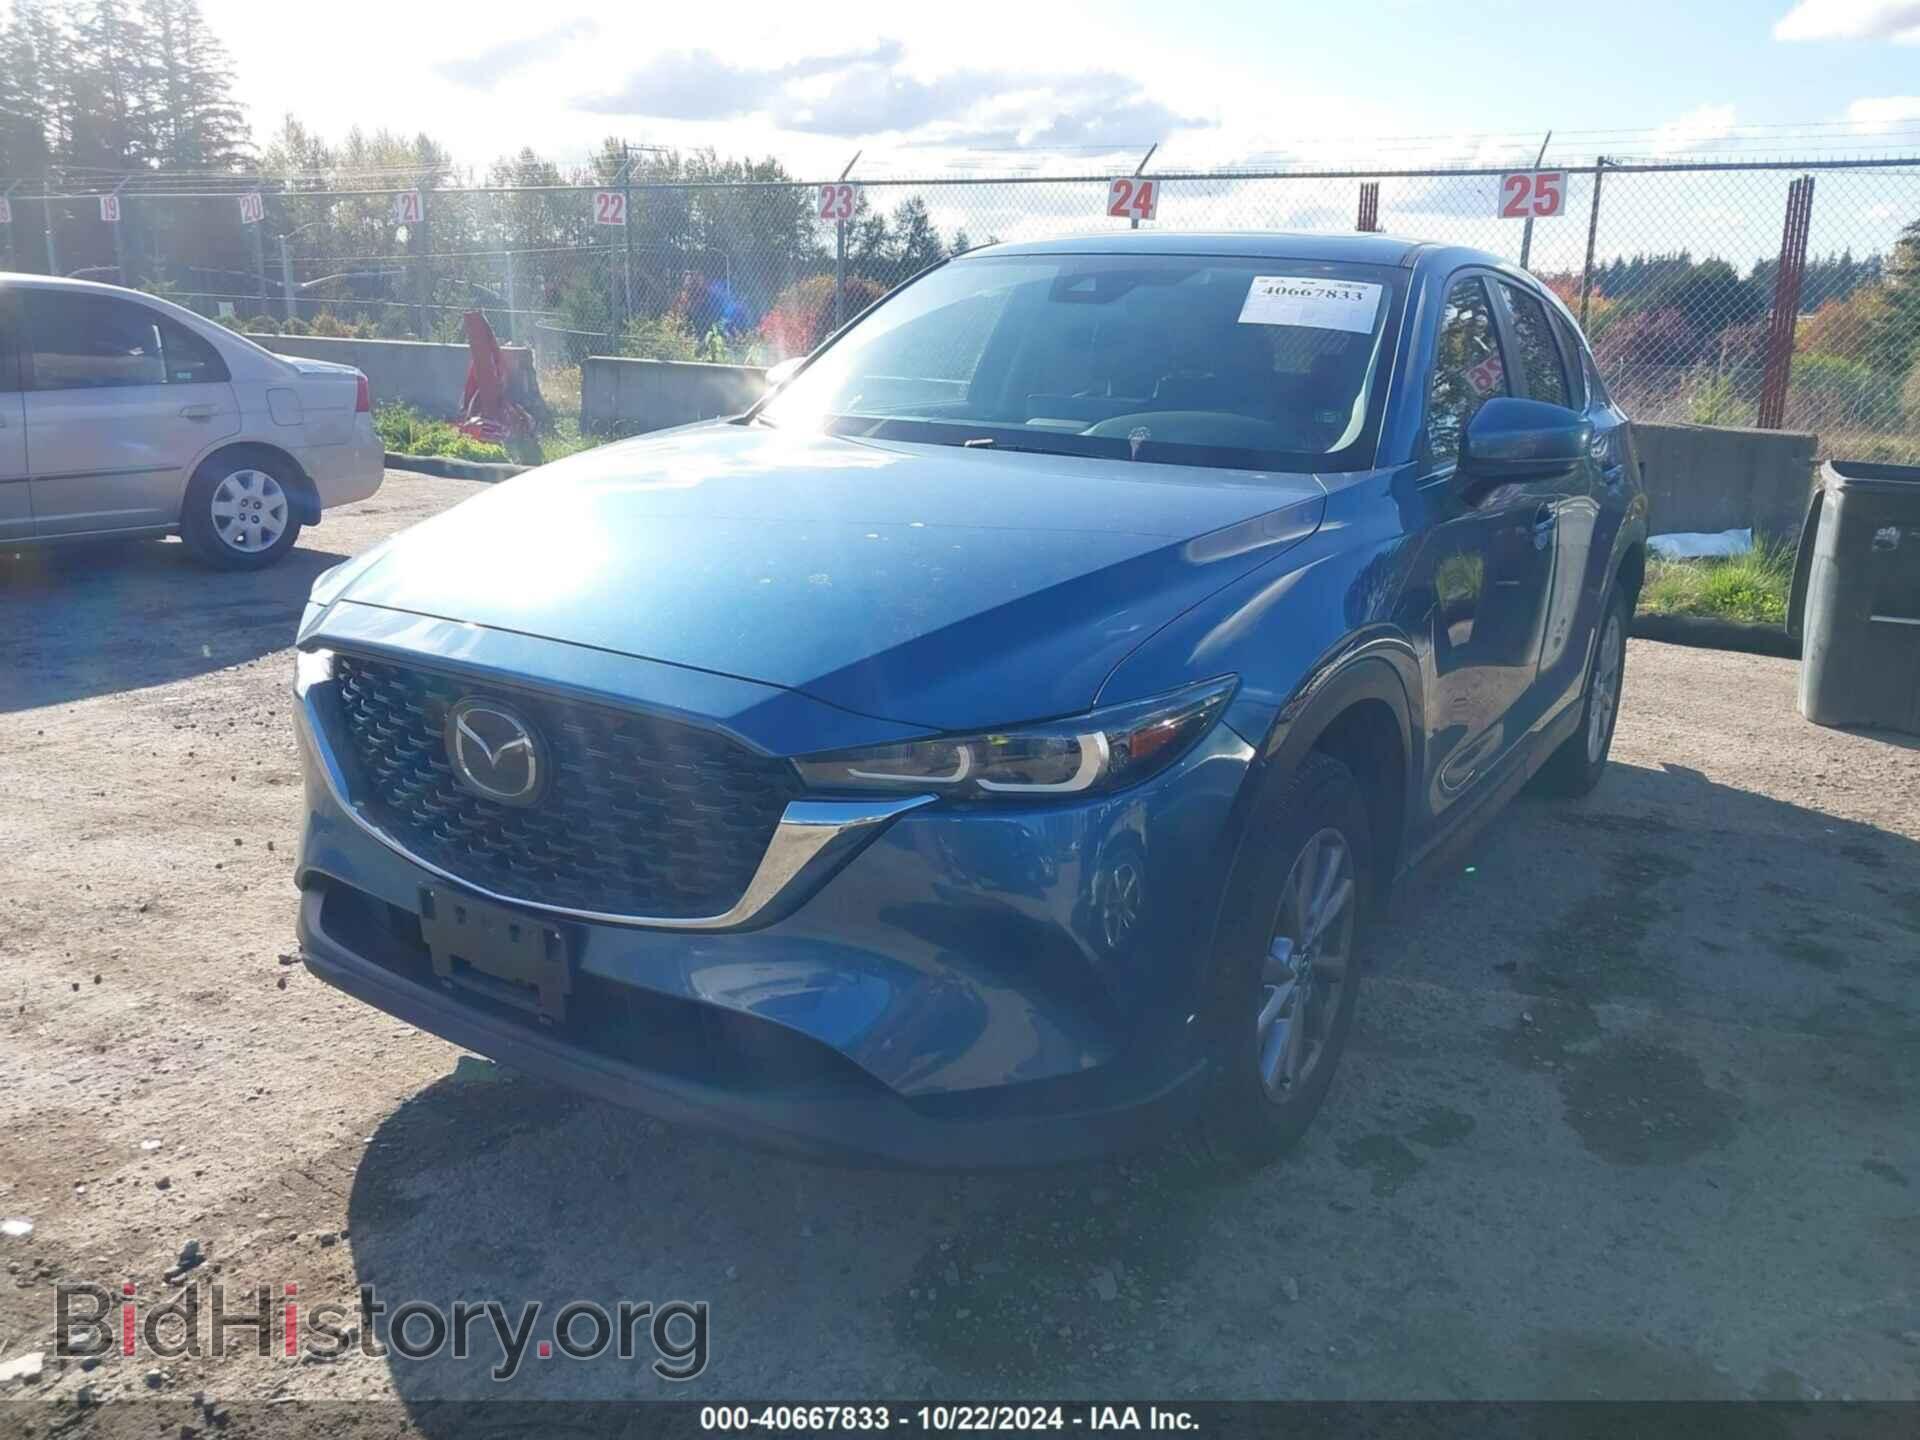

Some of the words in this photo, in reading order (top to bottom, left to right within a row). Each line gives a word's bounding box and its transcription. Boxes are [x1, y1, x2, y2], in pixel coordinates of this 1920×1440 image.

[242, 195, 262, 221] 20
[402, 193, 419, 222] 21
[597, 194, 624, 224] 22
[820, 186, 852, 219] 23
[1110, 178, 1153, 219] 24
[1503, 173, 1560, 216] 25
[1262, 286, 1365, 302] 40667833
